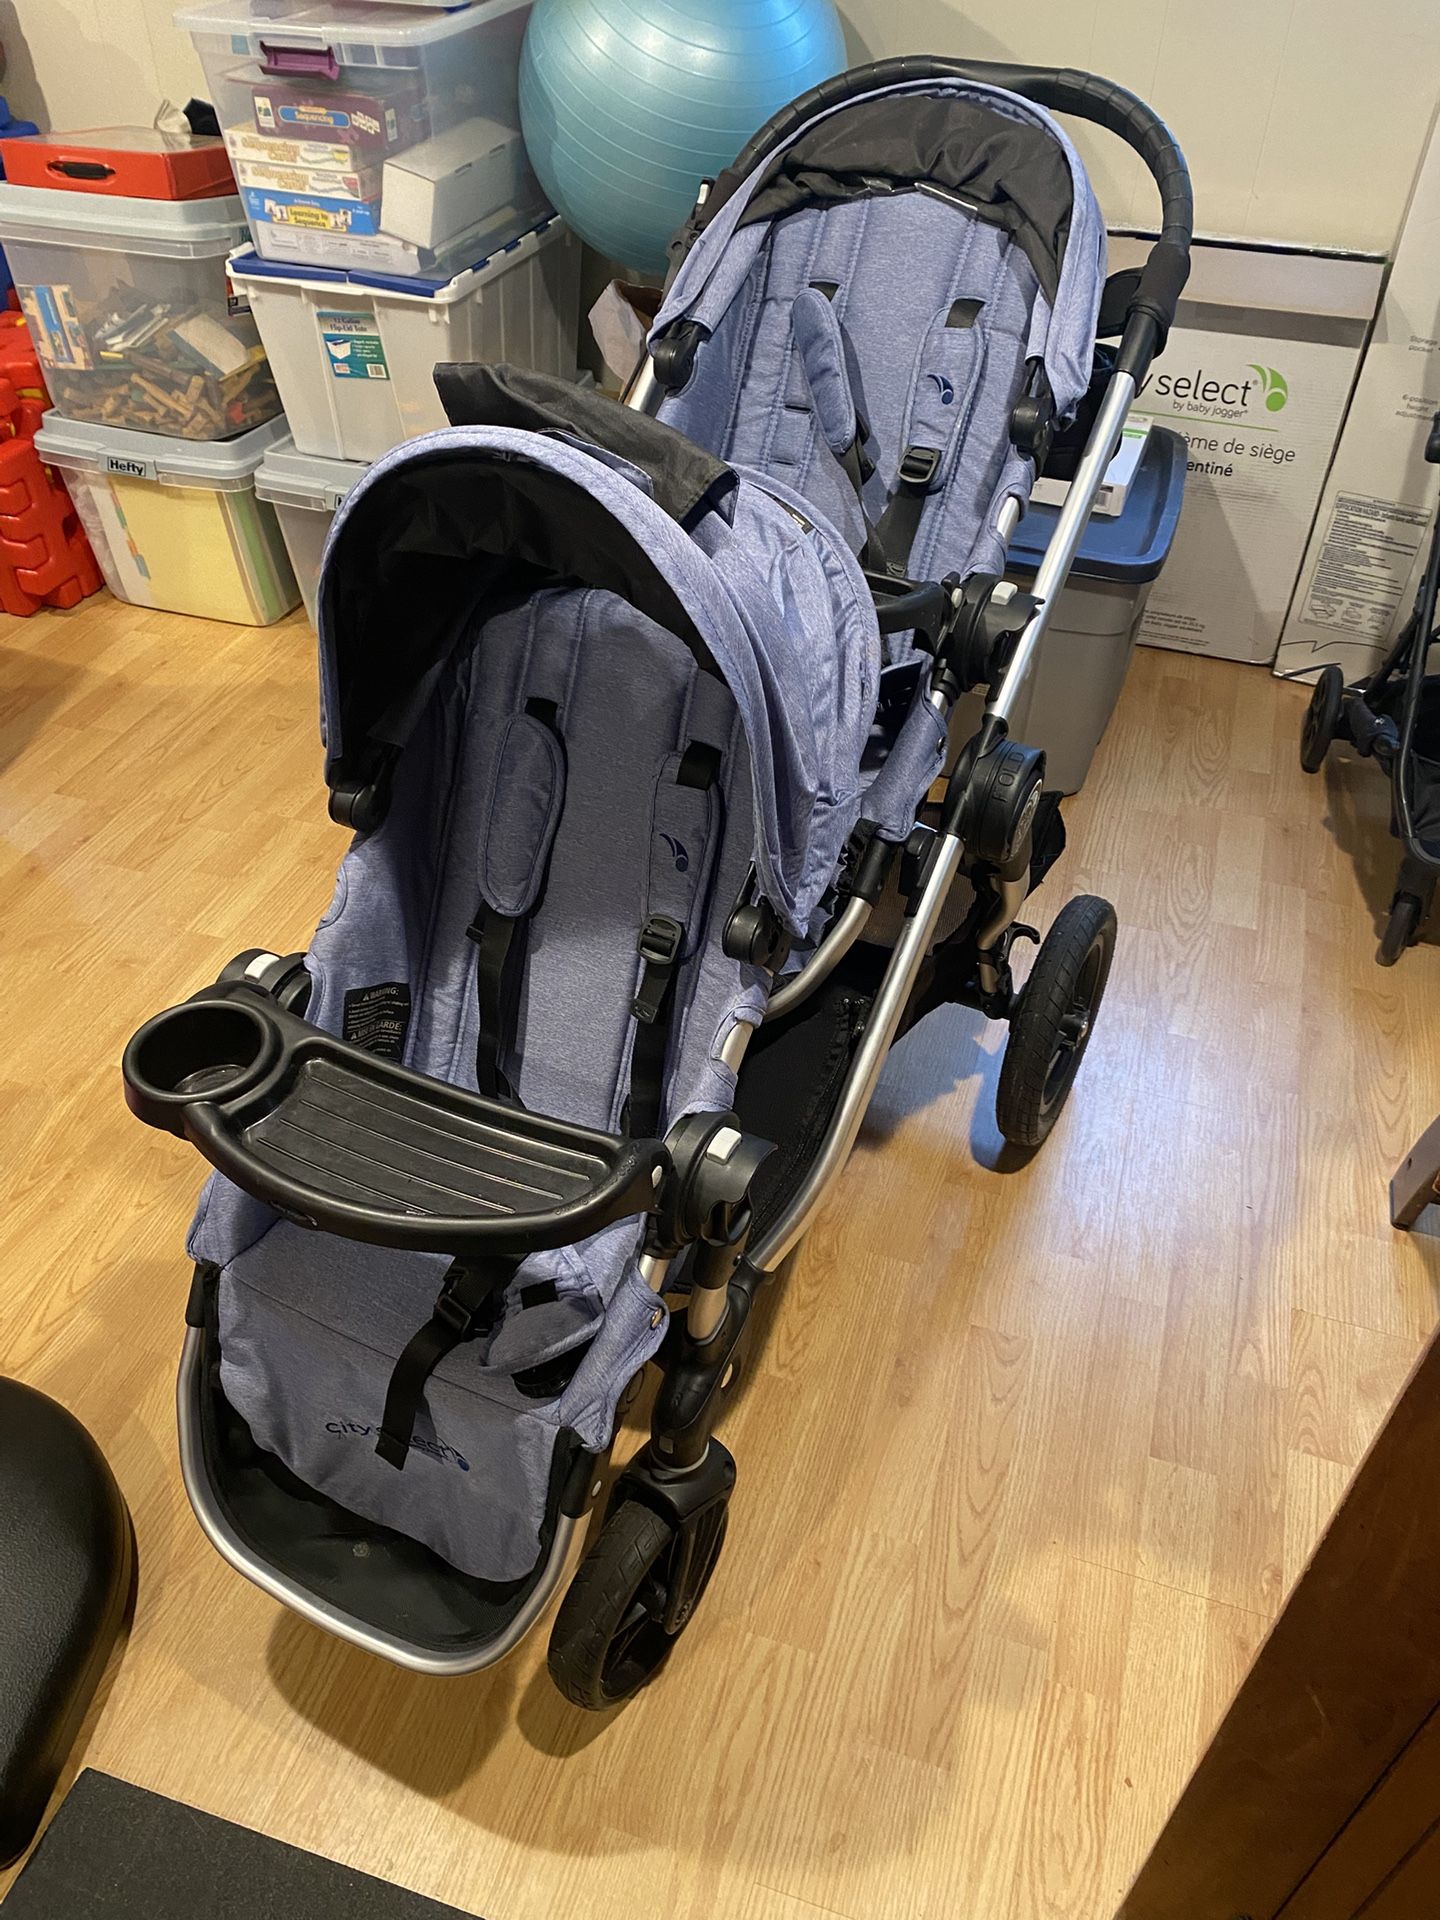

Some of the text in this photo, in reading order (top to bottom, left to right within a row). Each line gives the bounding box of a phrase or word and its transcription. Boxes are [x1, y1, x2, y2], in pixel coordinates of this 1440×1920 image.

[1155, 369, 1251, 407] select
[1172, 400, 1245, 418] by baby jogger
[1223, 437, 1245, 455] de
[1249, 442, 1296, 465] siège
[110, 459, 144, 476] Hefty
[1186, 461, 1234, 477] entiné
[991, 751, 1026, 804] FOLD
